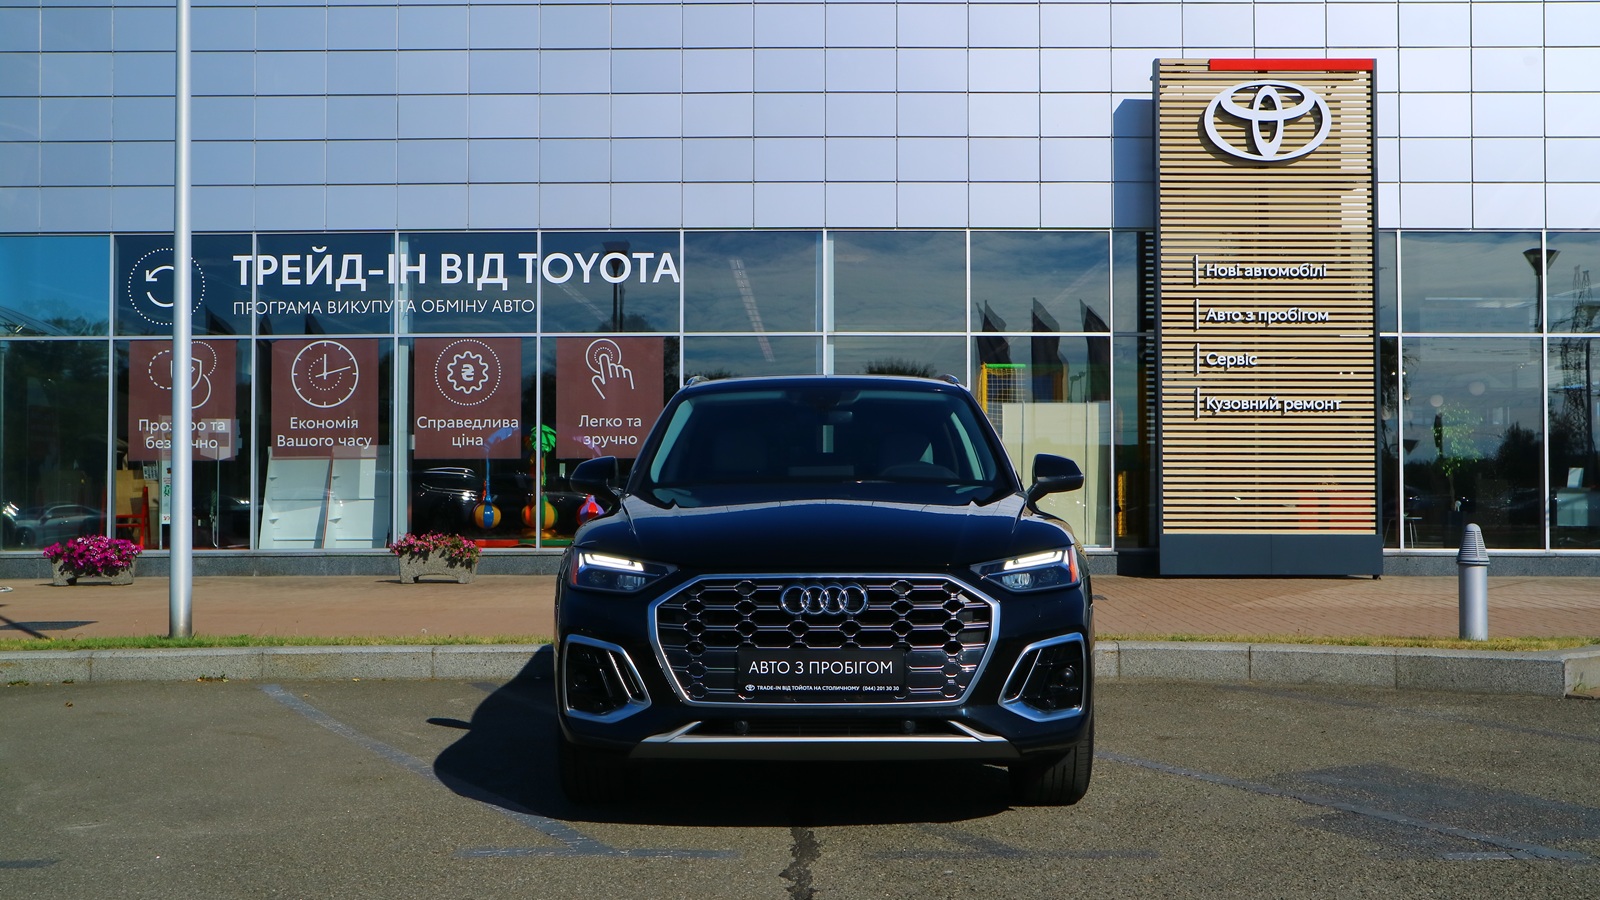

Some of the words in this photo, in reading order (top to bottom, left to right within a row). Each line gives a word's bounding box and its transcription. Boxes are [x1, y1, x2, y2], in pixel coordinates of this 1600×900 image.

[232, 246, 426, 292] ТРЕЙД-ІН
[440, 253, 508, 291] ВІД
[518, 252, 680, 284] TOYOTA
[1205, 263, 1240, 277] Нові
[1244, 263, 1327, 277] автомобілі
[233, 301, 322, 315] ПРОГРАМА
[327, 300, 394, 314] ВИКУПУ
[398, 299, 417, 313] ТА
[421, 299, 488, 313] ОБМІНУ
[491, 299, 535, 313] АВТО
[1205, 308, 1242, 322] Авто
[1245, 310, 1254, 322] з
[1258, 307, 1329, 325] пробігом
[1205, 352, 1258, 368] Сервіс
[1205, 396, 1279, 412] Кузовний
[1283, 399, 1342, 413] ремонт
[210, 421, 226, 431] та
[290, 416, 359, 430] Економія
[416, 416, 519, 431] Справедлива
[578, 415, 622, 429] Легко
[626, 417, 642, 428] та
[145, 435, 218, 449] безчно
[276, 434, 334, 447] Вашого
[338, 437, 372, 450] часу
[451, 434, 484, 449] ціна
[583, 435, 638, 449] зручно
[748, 661, 791, 675] АВТО
[809, 661, 893, 675] ПРОБІГОМ
